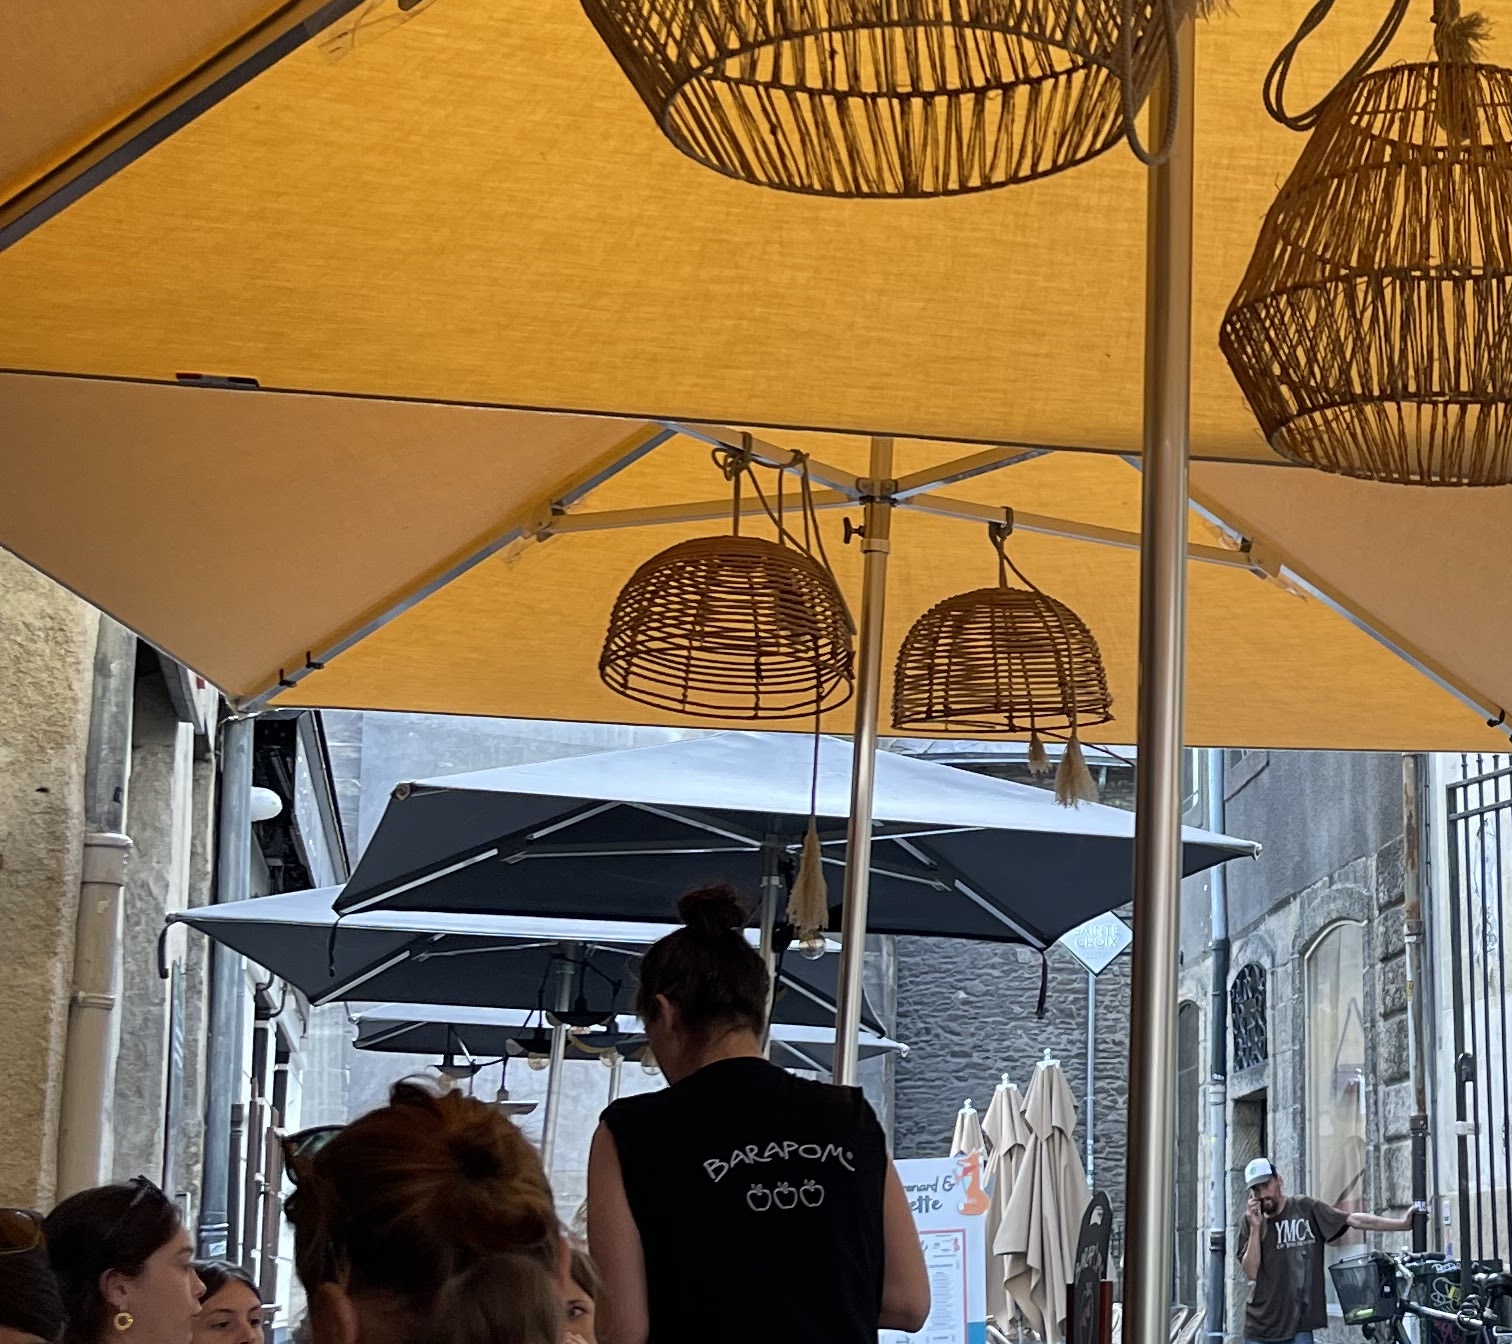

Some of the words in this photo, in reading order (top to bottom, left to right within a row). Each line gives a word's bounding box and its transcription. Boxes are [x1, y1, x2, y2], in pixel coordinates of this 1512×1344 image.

[1075, 924, 1120, 936] SAINTE
[1076, 937, 1117, 947] CROIX
[1275, 1218, 1316, 1243] YMCA
